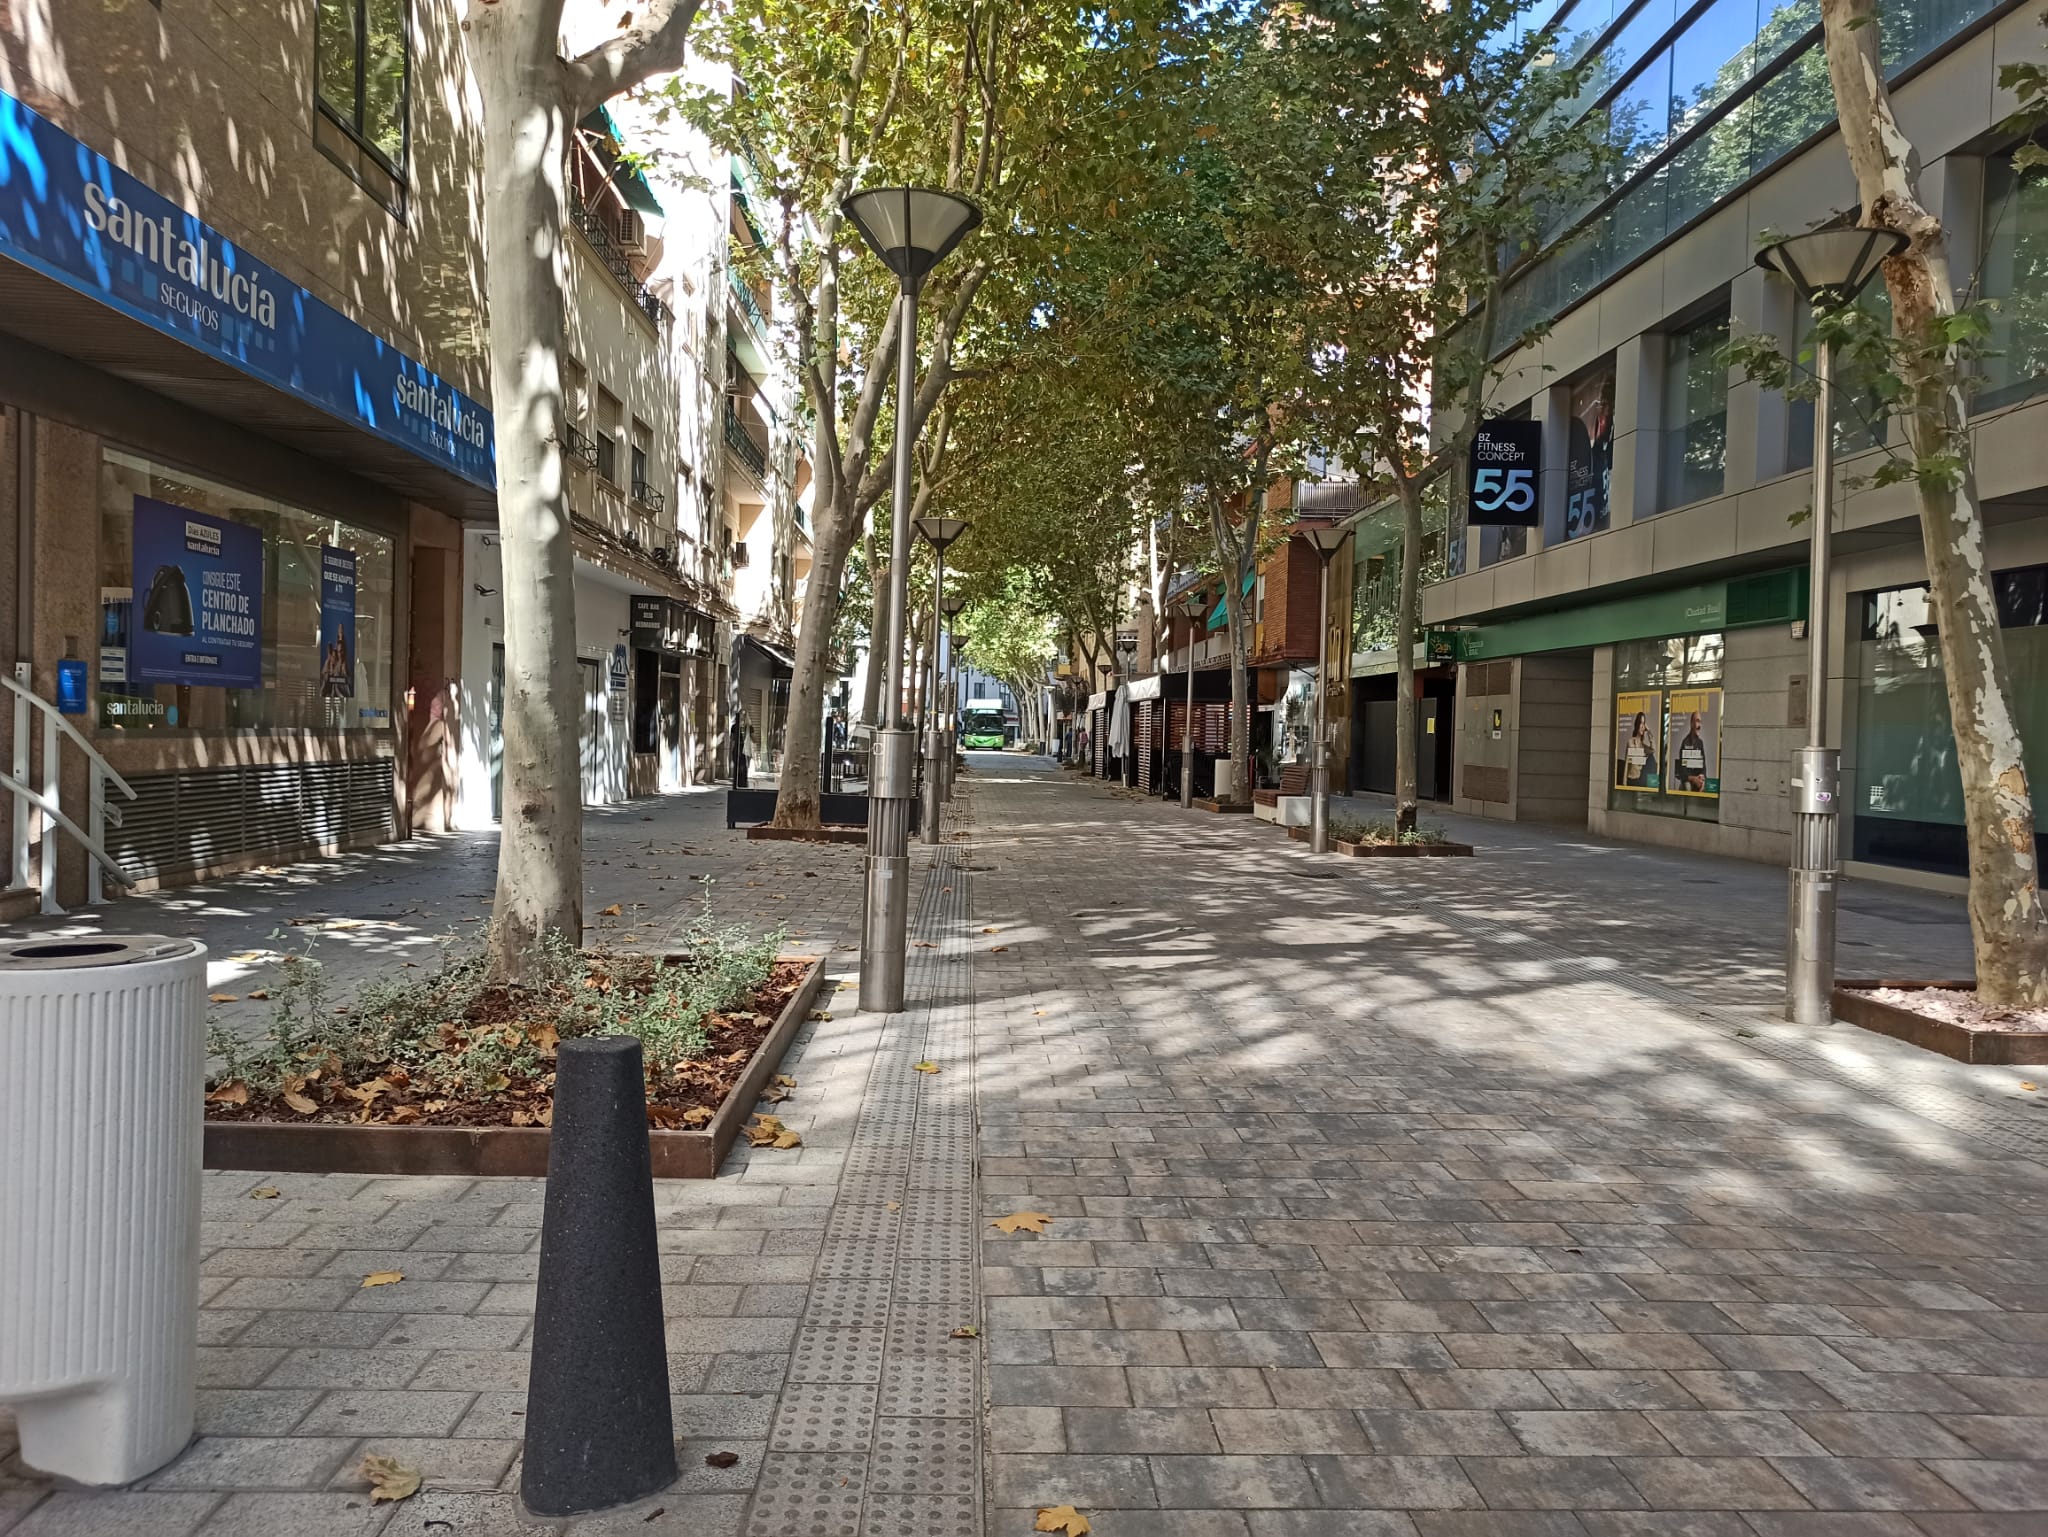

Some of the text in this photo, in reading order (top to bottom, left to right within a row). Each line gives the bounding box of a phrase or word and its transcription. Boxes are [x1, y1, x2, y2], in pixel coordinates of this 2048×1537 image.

[84, 183, 276, 330] santalucía
[160, 282, 219, 331] SEGUROS
[396, 373, 485, 449] santalucía
[1478, 433, 1491, 442] BZ
[1478, 443, 1516, 452] FITNESS
[1477, 452, 1525, 462] CONCEPT
[1474, 468, 1535, 512] 55
[1568, 488, 1596, 538] 55
[226, 573, 241, 592] ESTE
[202, 588, 249, 614] CENTRO DE
[202, 611, 255, 636] PLANCHADO
